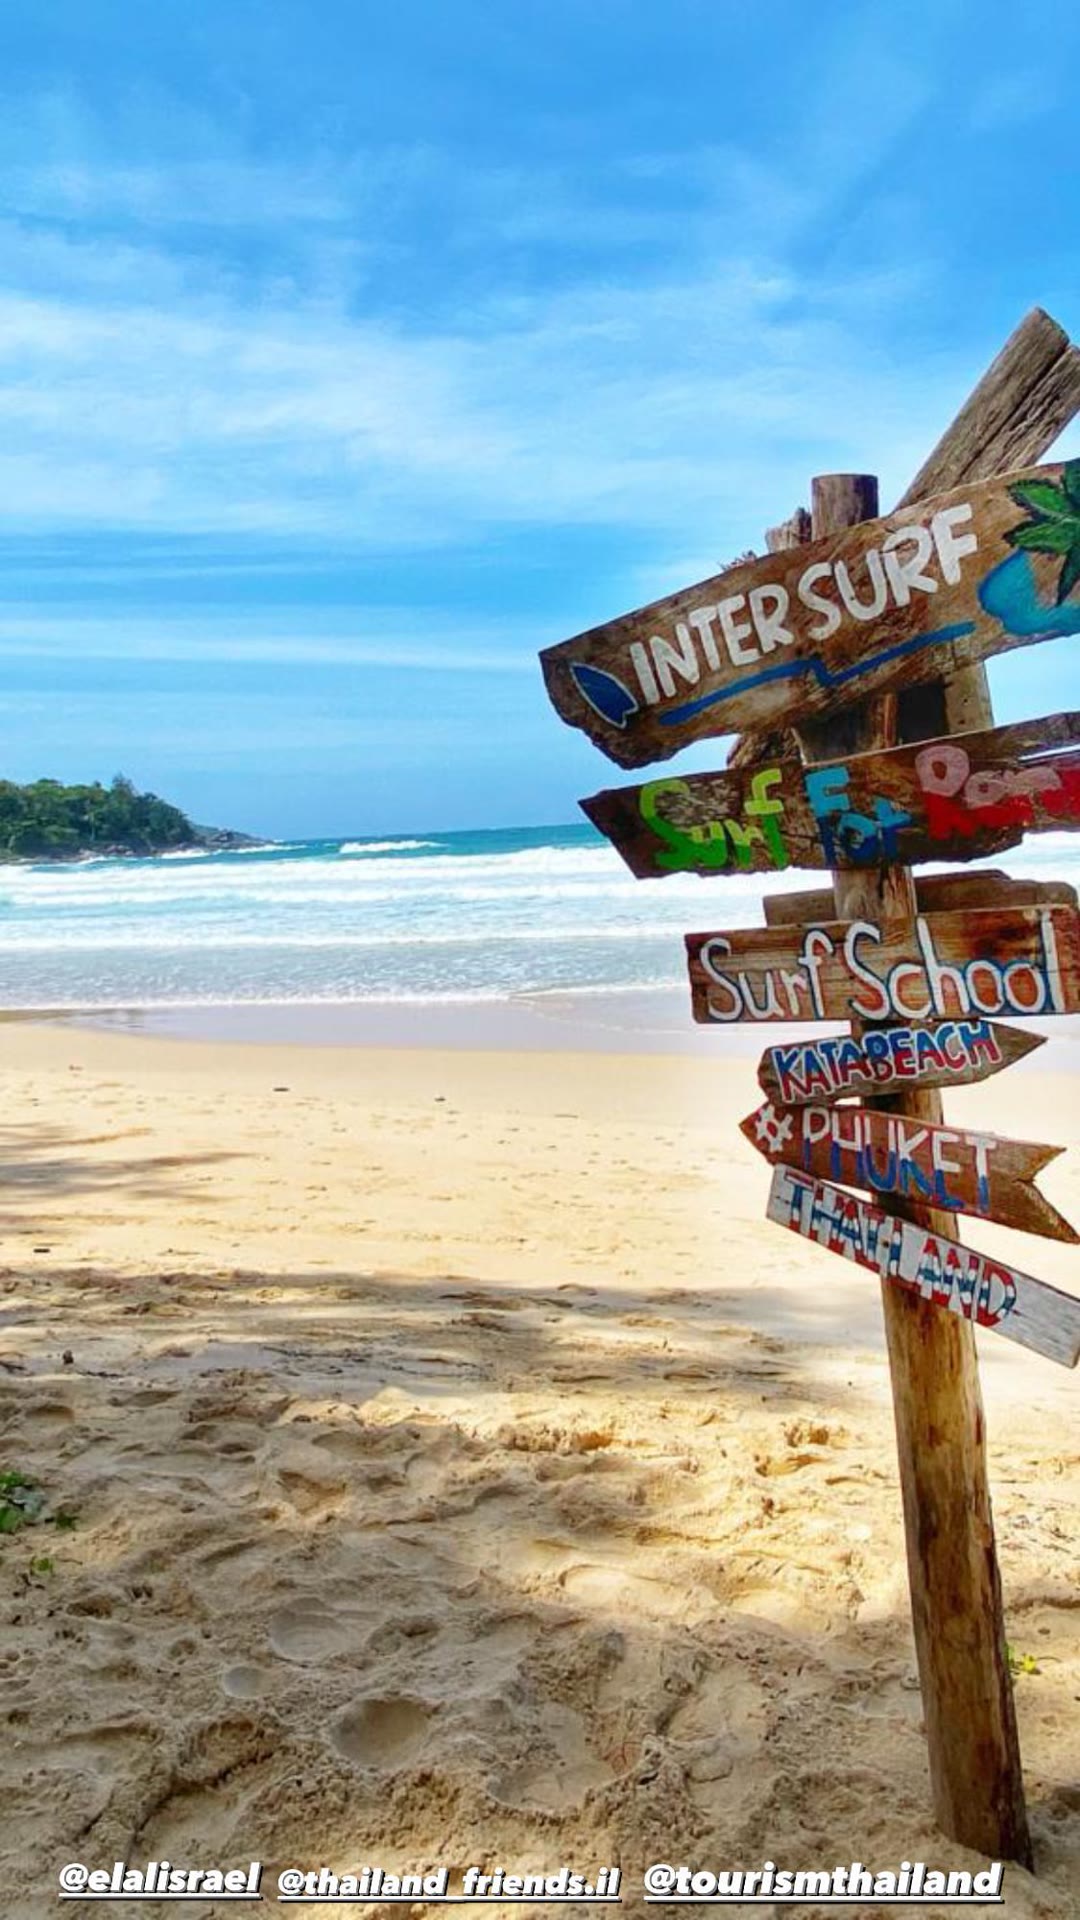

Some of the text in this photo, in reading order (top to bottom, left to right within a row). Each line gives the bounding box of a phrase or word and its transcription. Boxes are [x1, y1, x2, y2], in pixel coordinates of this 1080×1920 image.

[630, 504, 977, 704] INTER SURF
[639, 768, 787, 870] Surf
[700, 912, 1064, 1021] Surf School
[803, 1106, 996, 1213] PHUKET
[784, 1168, 1018, 1328] THAILAND
